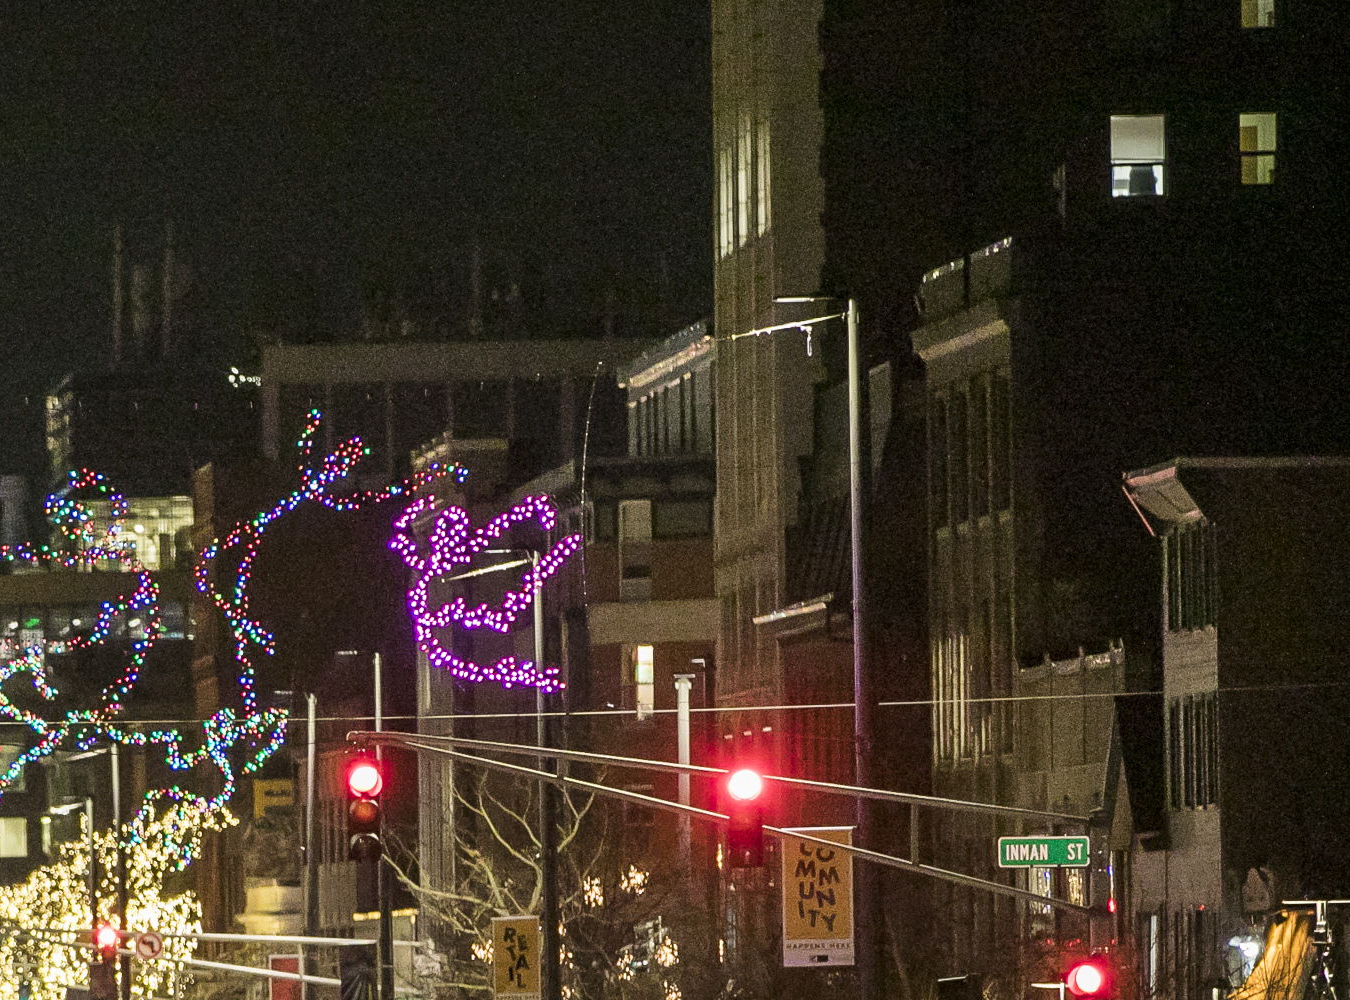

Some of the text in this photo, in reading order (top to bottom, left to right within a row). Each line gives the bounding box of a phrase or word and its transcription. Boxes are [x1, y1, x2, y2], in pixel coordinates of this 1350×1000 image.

[1006, 843, 1083, 861] INMAN ST
[786, 942, 826, 950] HAPPENS
